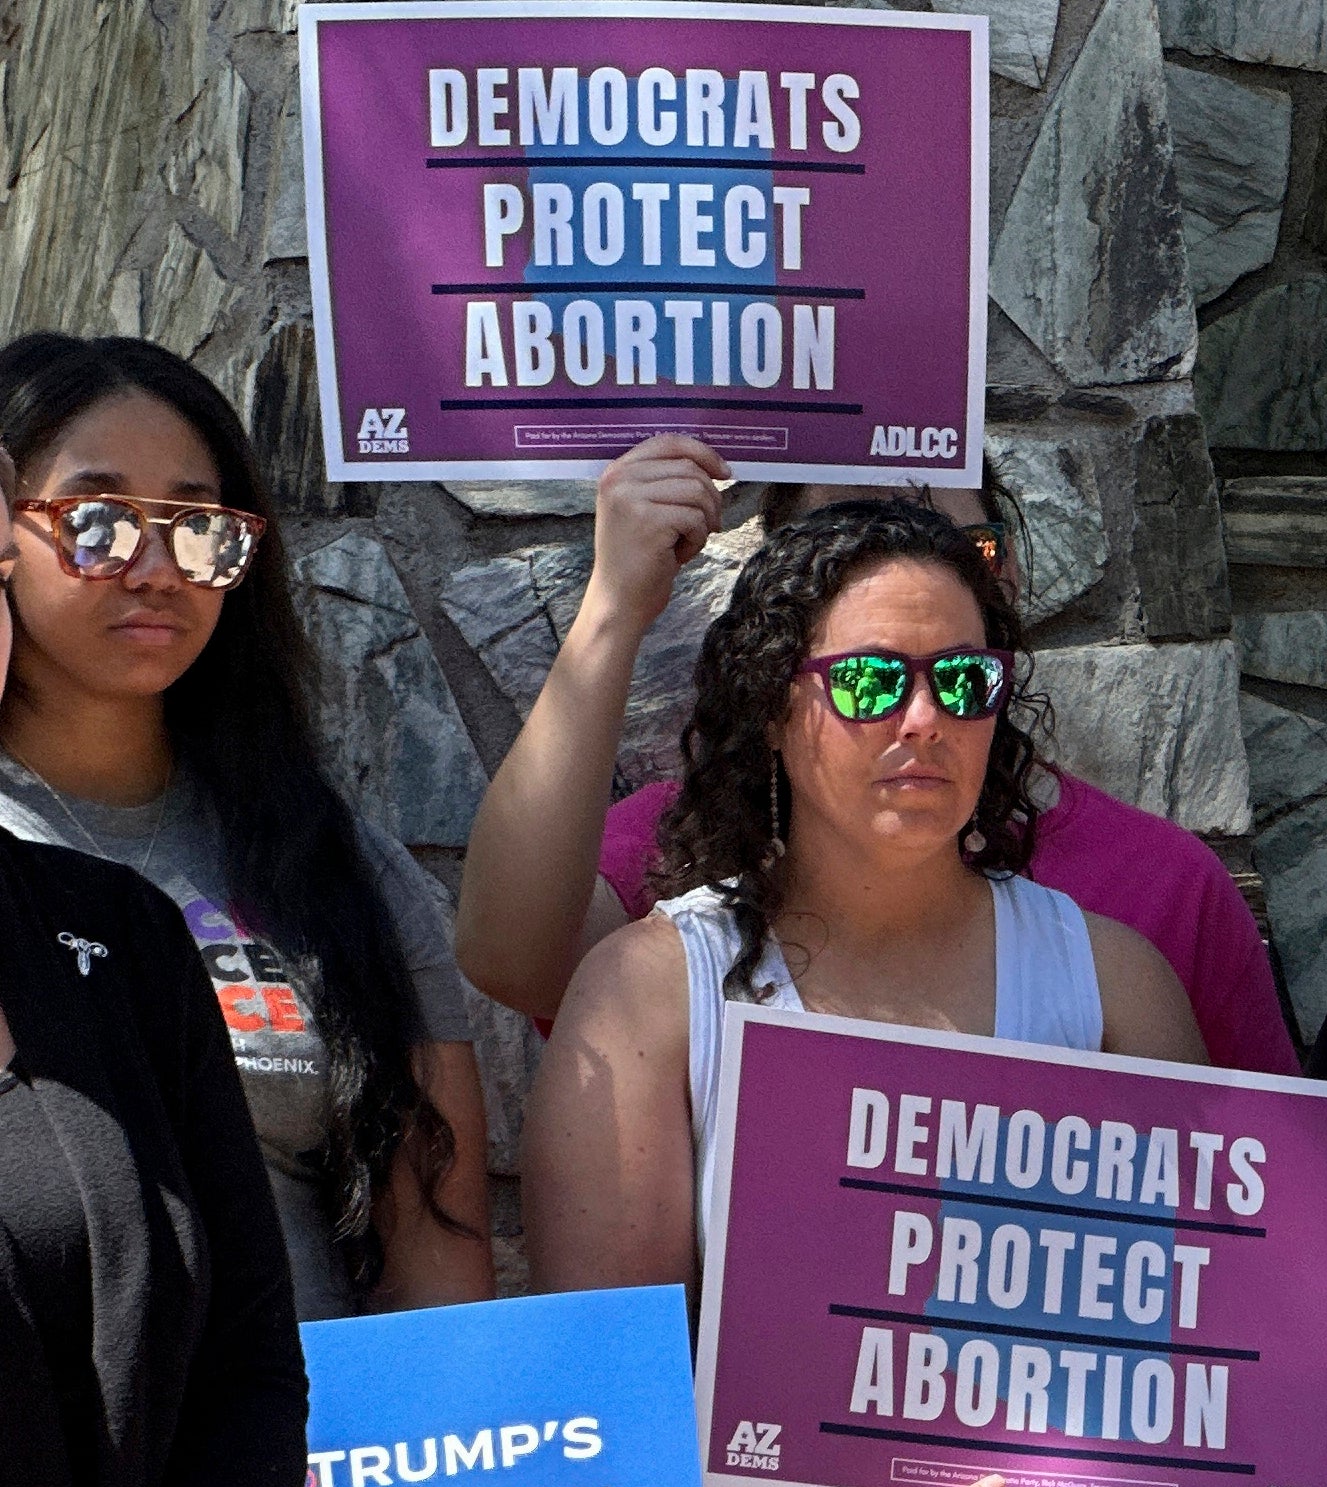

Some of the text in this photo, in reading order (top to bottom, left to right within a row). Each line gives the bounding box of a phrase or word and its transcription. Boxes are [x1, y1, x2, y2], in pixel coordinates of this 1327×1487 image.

[428, 66, 861, 153] DEMOCRATS
[483, 181, 810, 270] PROTECT
[465, 300, 835, 390] ABORTION
[357, 408, 408, 439] AZ
[359, 439, 409, 454] DEMS
[870, 425, 958, 459] ADLCC
[847, 1087, 1267, 1217] DEMOCRATS
[888, 1210, 1211, 1330] PROTECT
[849, 1327, 1230, 1450] ABORTION
[725, 1452, 779, 1471] DEMS
[726, 1421, 782, 1456] AZ
